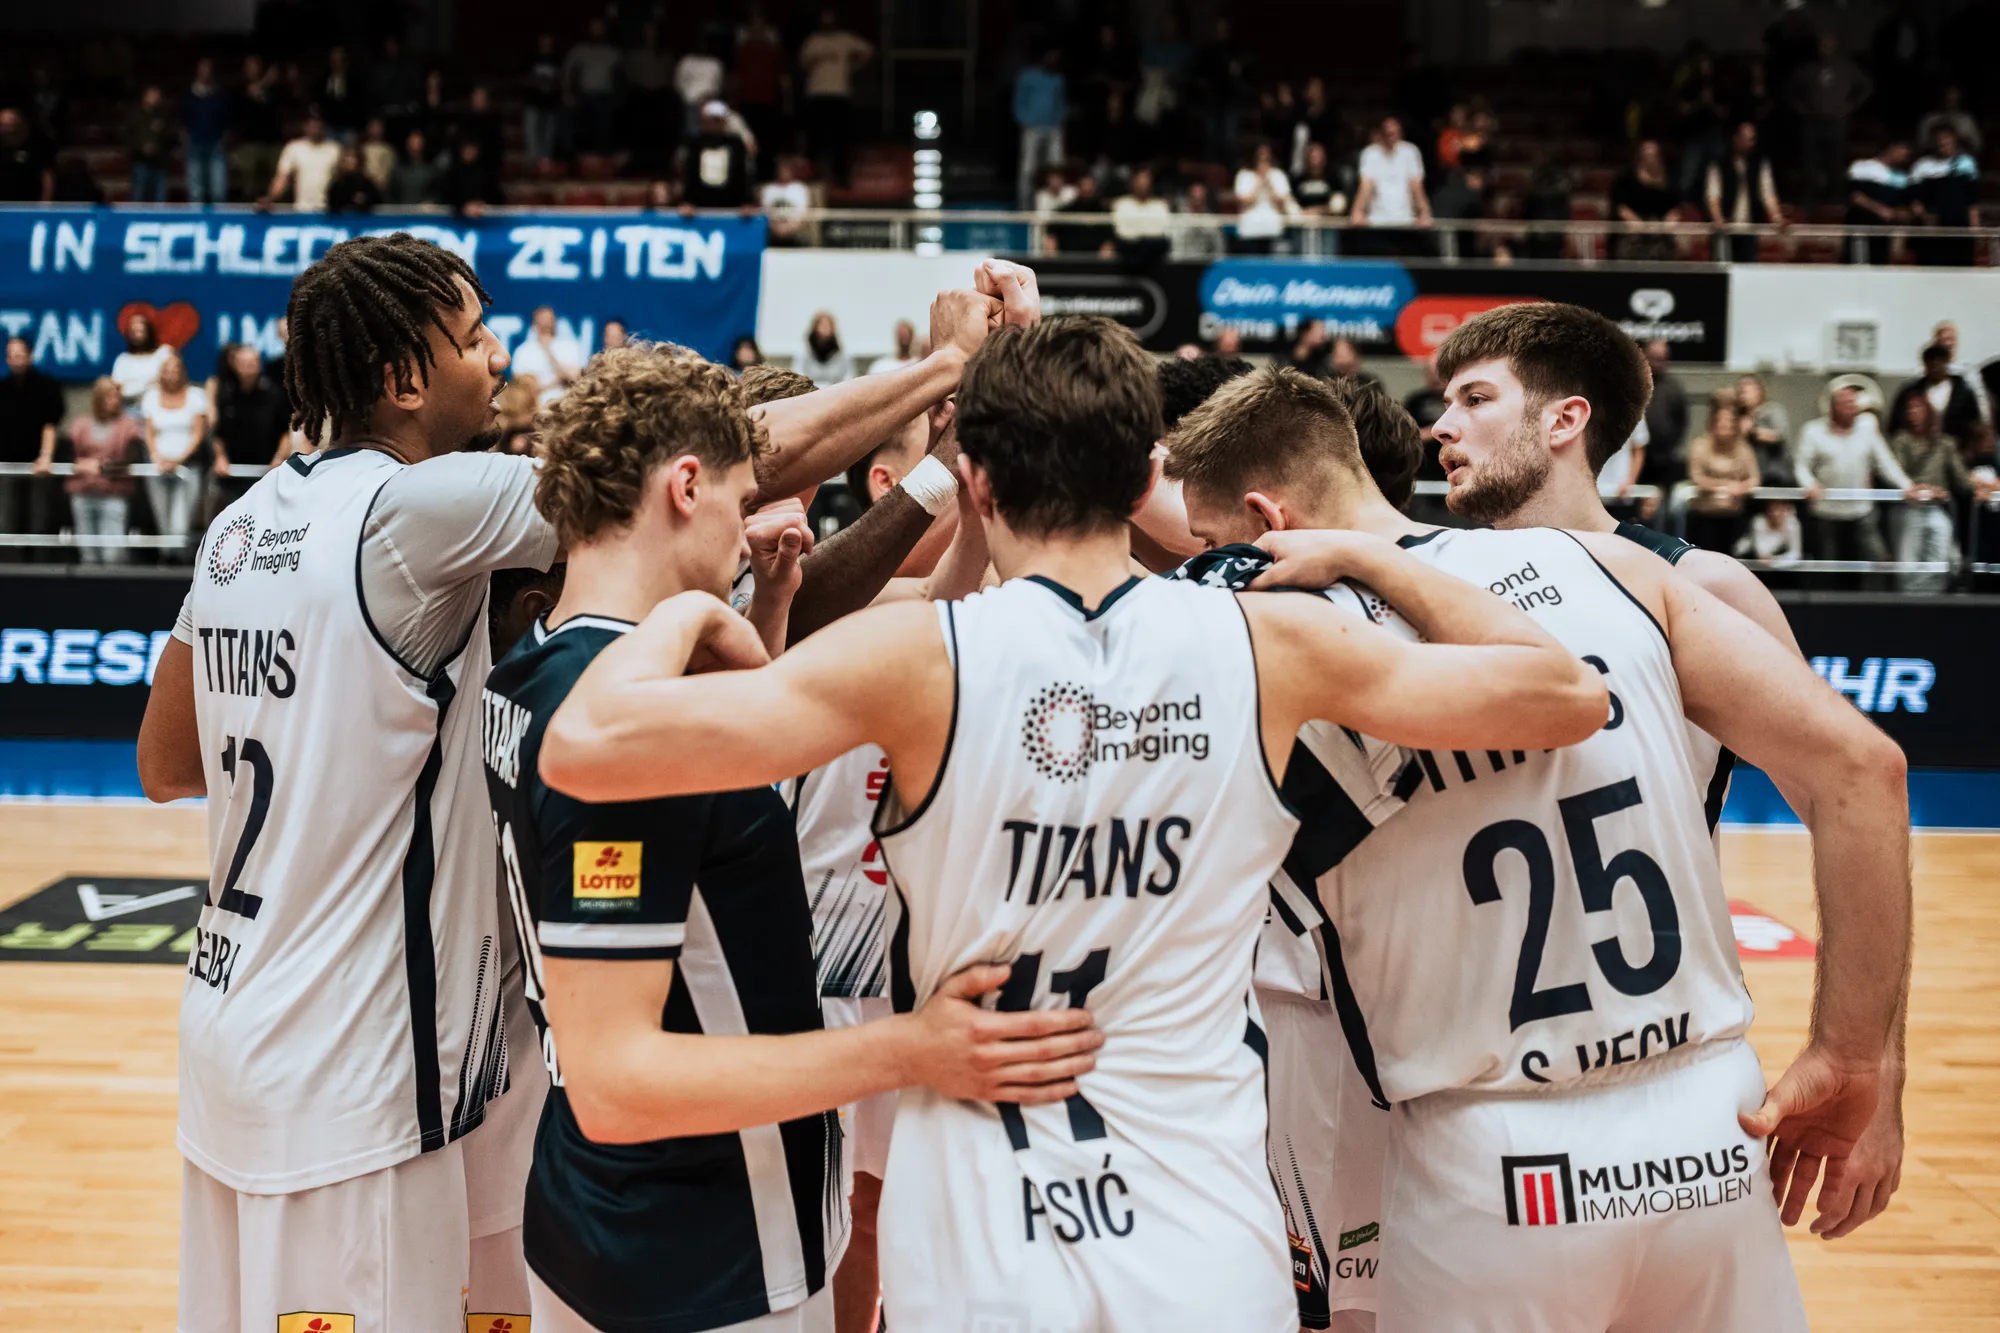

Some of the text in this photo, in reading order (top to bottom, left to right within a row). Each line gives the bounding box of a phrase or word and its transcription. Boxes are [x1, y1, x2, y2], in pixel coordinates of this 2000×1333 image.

[29, 221, 96, 273] IN
[507, 225, 726, 280] ZEITEN
[251, 547, 301, 575] Imaging
[257, 522, 311, 551] Beyond
[199, 627, 297, 699] TITANS
[1810, 656, 1937, 714] HR
[1093, 694, 1201, 734] Beyond
[1093, 726, 1210, 763] Imaging
[580, 874, 635, 890] LOTTO
[1001, 816, 1192, 906] TITANS
[1462, 776, 1682, 1033] 25
[189, 926, 242, 995] EIBA
[1578, 1144, 1749, 1195] MUNDUS
[1581, 1174, 1753, 1223] IMMOBILIEN
